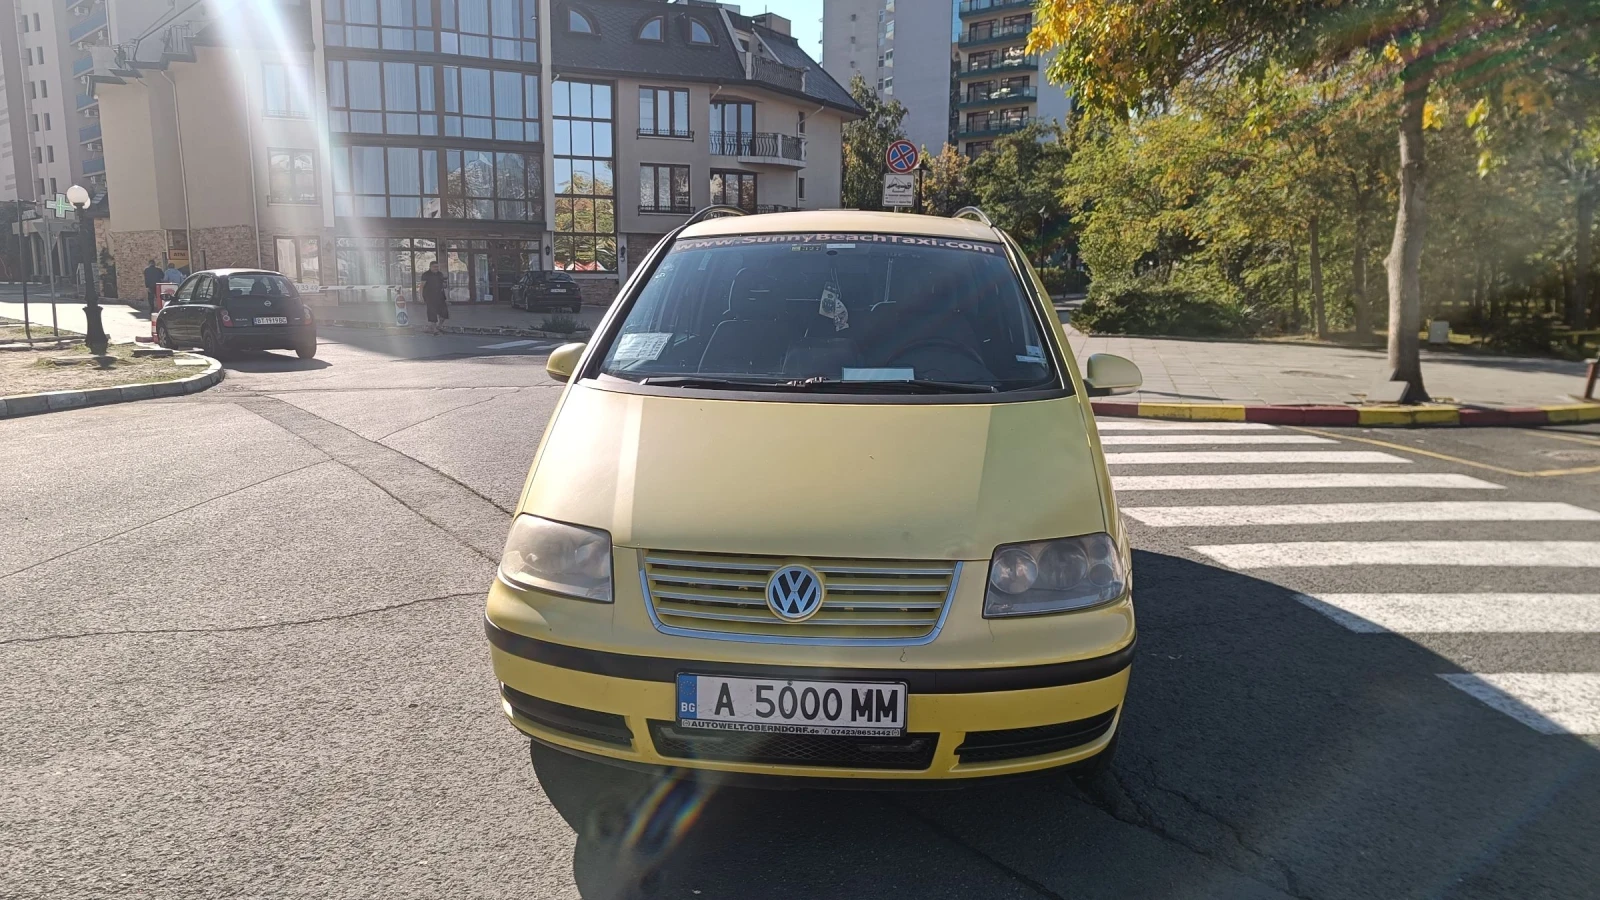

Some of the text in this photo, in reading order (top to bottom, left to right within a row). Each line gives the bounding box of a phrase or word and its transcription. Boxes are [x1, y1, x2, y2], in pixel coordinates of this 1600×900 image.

[681, 702, 696, 713] BG
[714, 682, 899, 723] A 5000 MM
